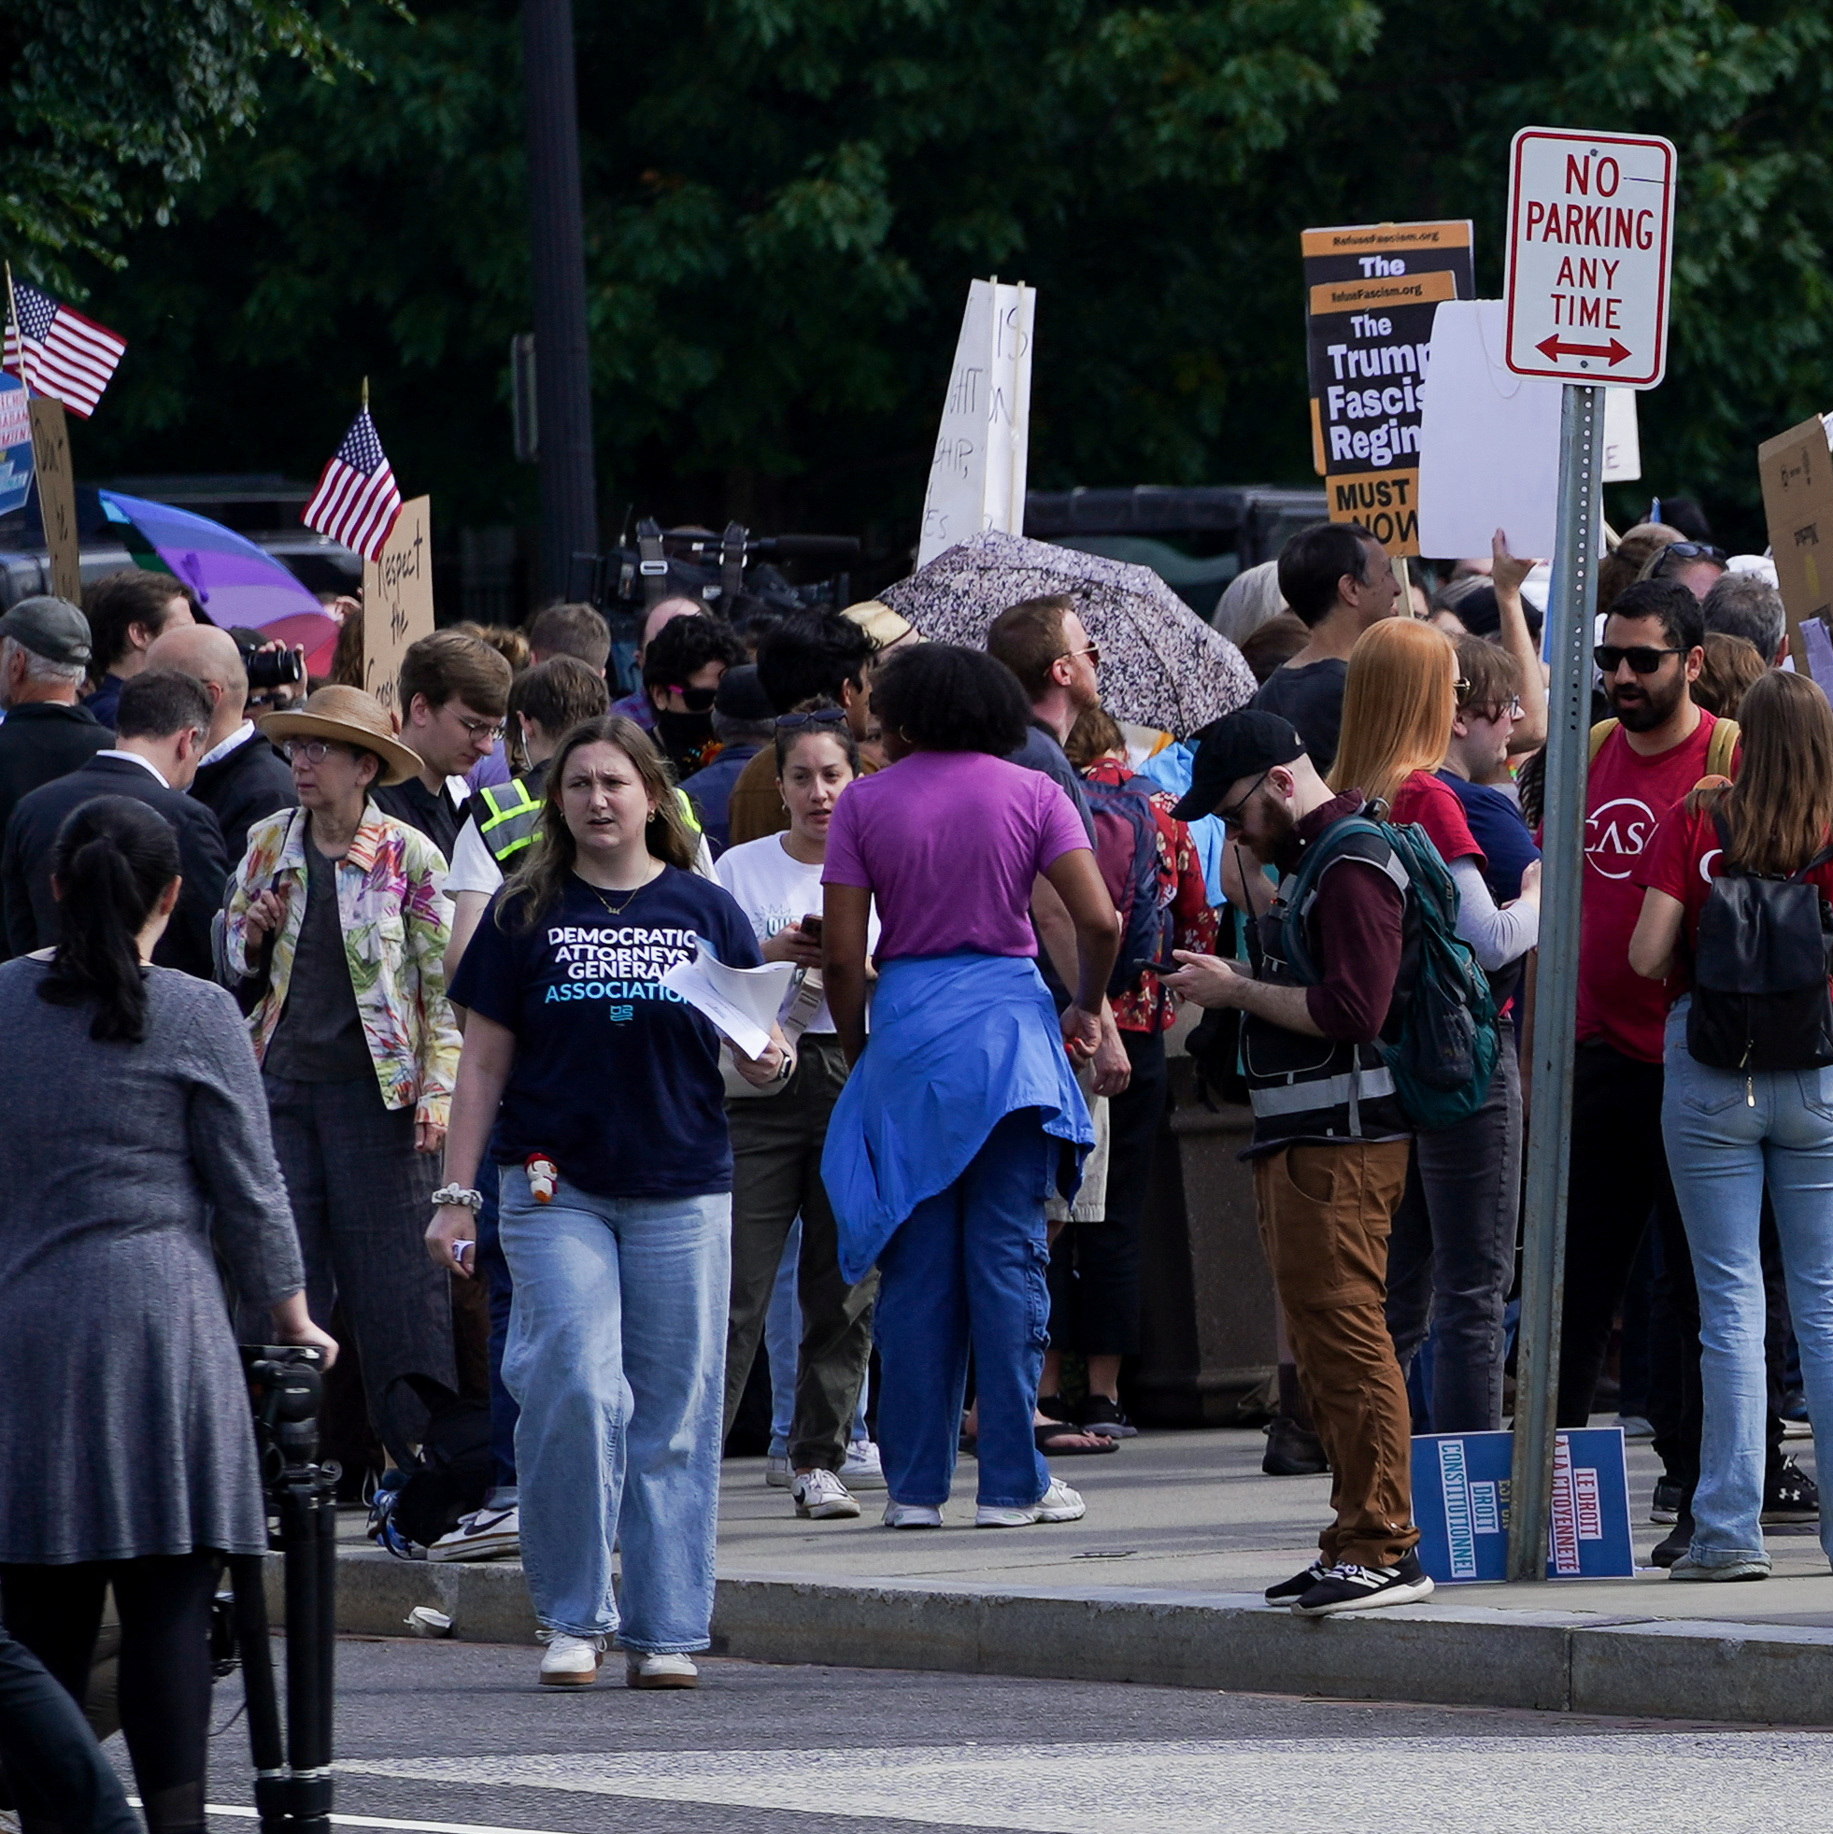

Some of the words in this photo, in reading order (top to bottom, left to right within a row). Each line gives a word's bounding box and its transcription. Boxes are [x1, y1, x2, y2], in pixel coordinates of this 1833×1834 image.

[1566, 153, 1619, 197] NO
[1525, 201, 1654, 250] PARKING
[1358, 255, 1406, 278] The
[1556, 256, 1620, 290] ANY
[1350, 314, 1393, 338] The
[1551, 294, 1622, 329] TIME
[1336, 479, 1409, 511] MUST
[1584, 820, 1660, 855] CAS
[548, 926, 698, 949] DEMOCRATIC
[554, 944, 692, 963] ATTORNEYS
[545, 981, 690, 1004] ASSOCIATIO
[1442, 1444, 1475, 1576] CONSTITUTIONNEL
[1472, 1485, 1496, 1530] DROIT
[1578, 1491, 1598, 1535] DROIT
